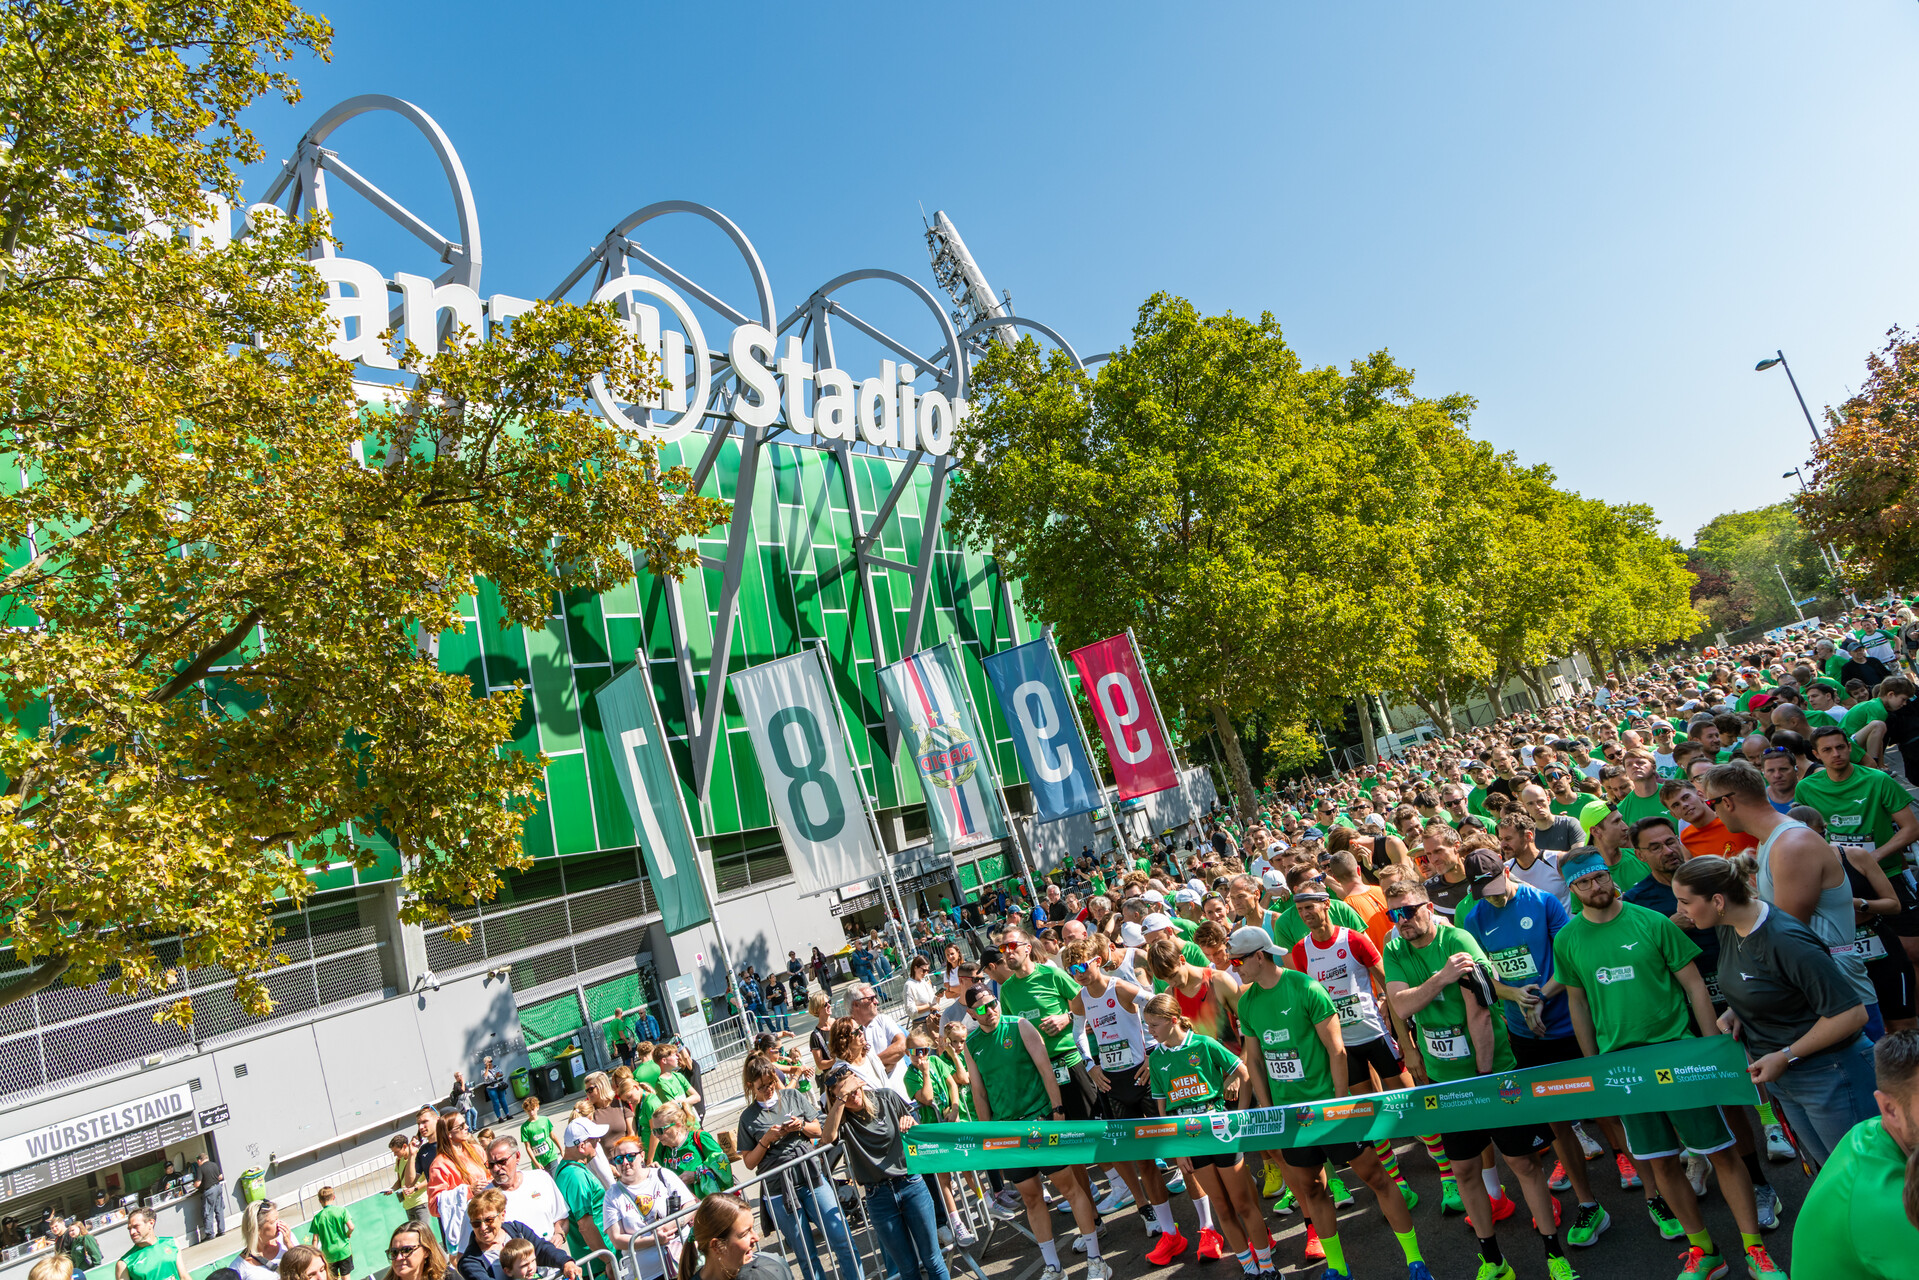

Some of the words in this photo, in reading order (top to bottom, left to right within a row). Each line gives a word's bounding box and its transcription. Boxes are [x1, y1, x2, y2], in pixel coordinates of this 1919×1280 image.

[1497, 957, 1527, 973] 1235
[1431, 1039, 1453, 1052] 407
[1106, 1051, 1122, 1063] 577
[1270, 1061, 1295, 1074] 1358
[1609, 1066, 1636, 1075] WIENER
[1674, 1064, 1717, 1074] Raiffeisen
[1173, 1075, 1197, 1088] WIEN
[1605, 1076, 1643, 1086] ZUCKER
[1676, 1072, 1717, 1083] Stadtbank
[1718, 1070, 1739, 1079] Wien
[1565, 1081, 1591, 1090] ENERGIE
[1170, 1084, 1207, 1102] ENERGIE
[1439, 1091, 1474, 1100] Raiffeisen
[1499, 1088, 1522, 1097] RAPID
[1383, 1102, 1414, 1110] ZUCKER
[1440, 1098, 1473, 1108] Stadtbank
[1474, 1096, 1491, 1104] Wien
[1238, 1109, 1283, 1126] RAPIDLAUF
[26, 1093, 182, 1158] WÜRSTELSTAND
[1241, 1126, 1247, 1136] IN
[1248, 1123, 1282, 1135] HÜTTELDORF
